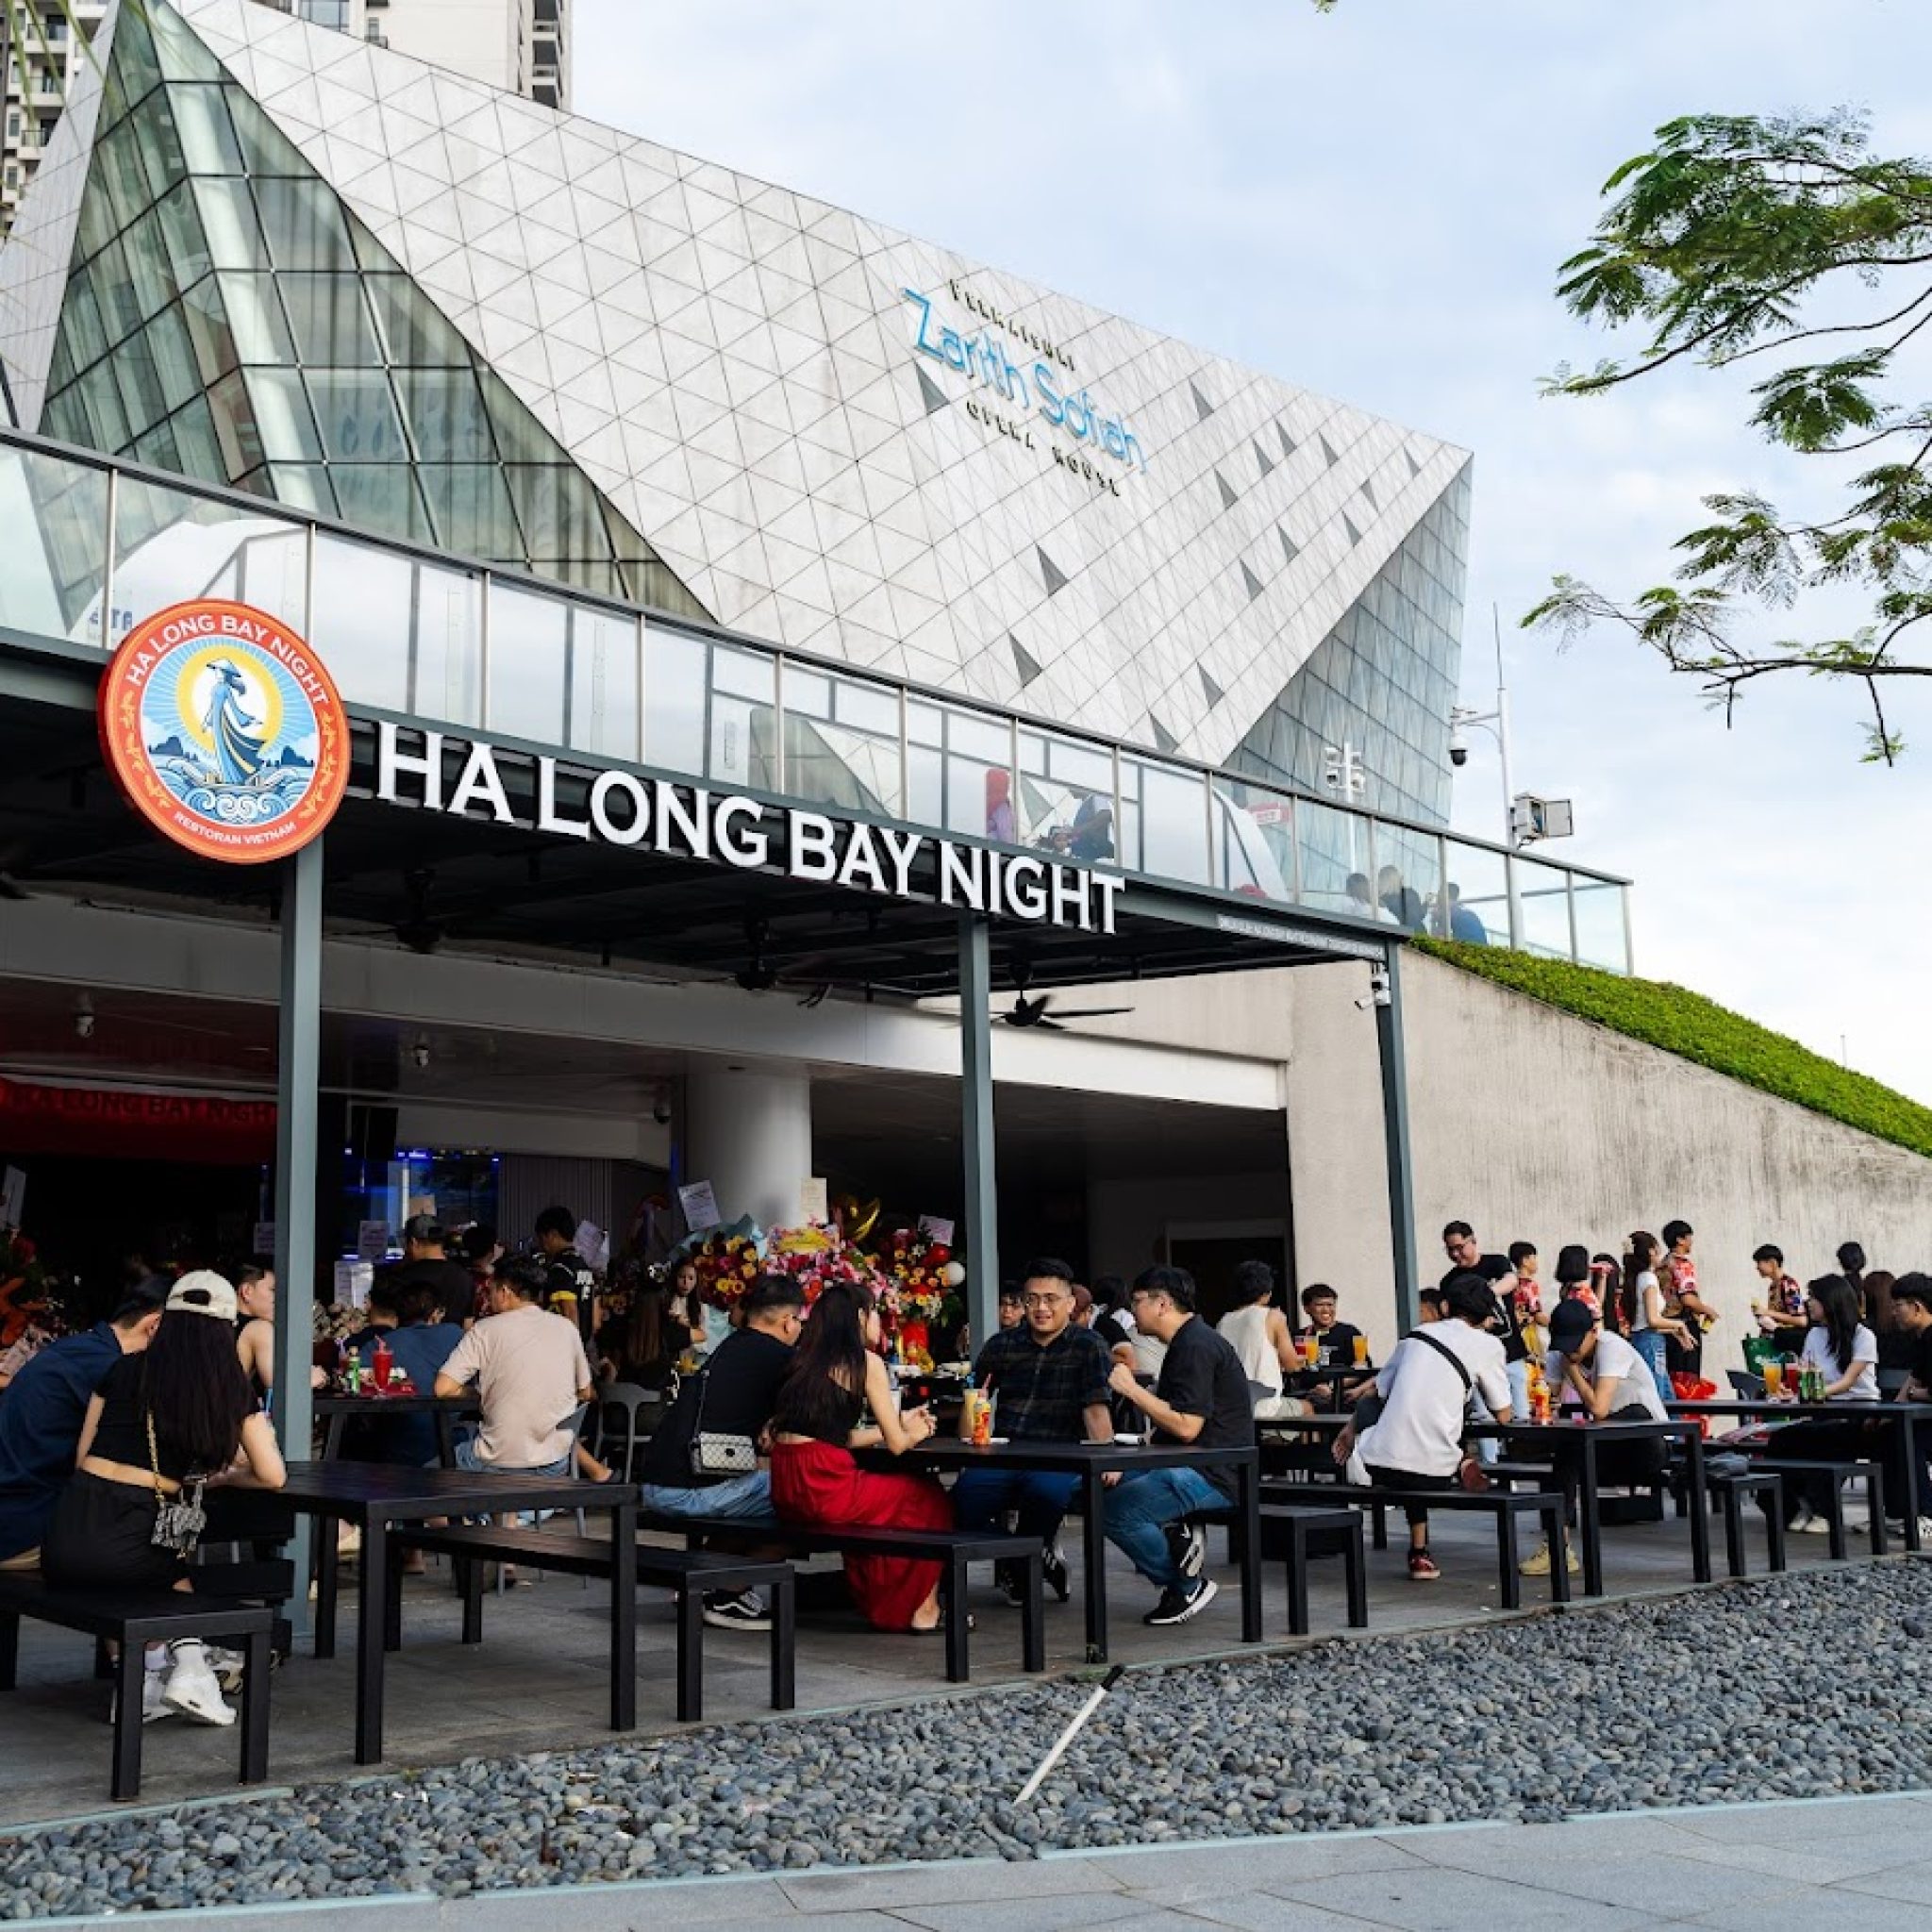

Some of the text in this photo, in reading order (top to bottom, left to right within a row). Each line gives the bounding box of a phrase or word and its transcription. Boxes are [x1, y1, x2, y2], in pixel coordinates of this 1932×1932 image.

[125, 651, 156, 688] HA
[149, 614, 216, 653] LONG
[221, 615, 270, 642] BAY
[271, 636, 330, 705] NIGHT
[377, 722, 1125, 935] HA LONG BAY NIGHT
[207, 1099, 276, 1124] NIGH
